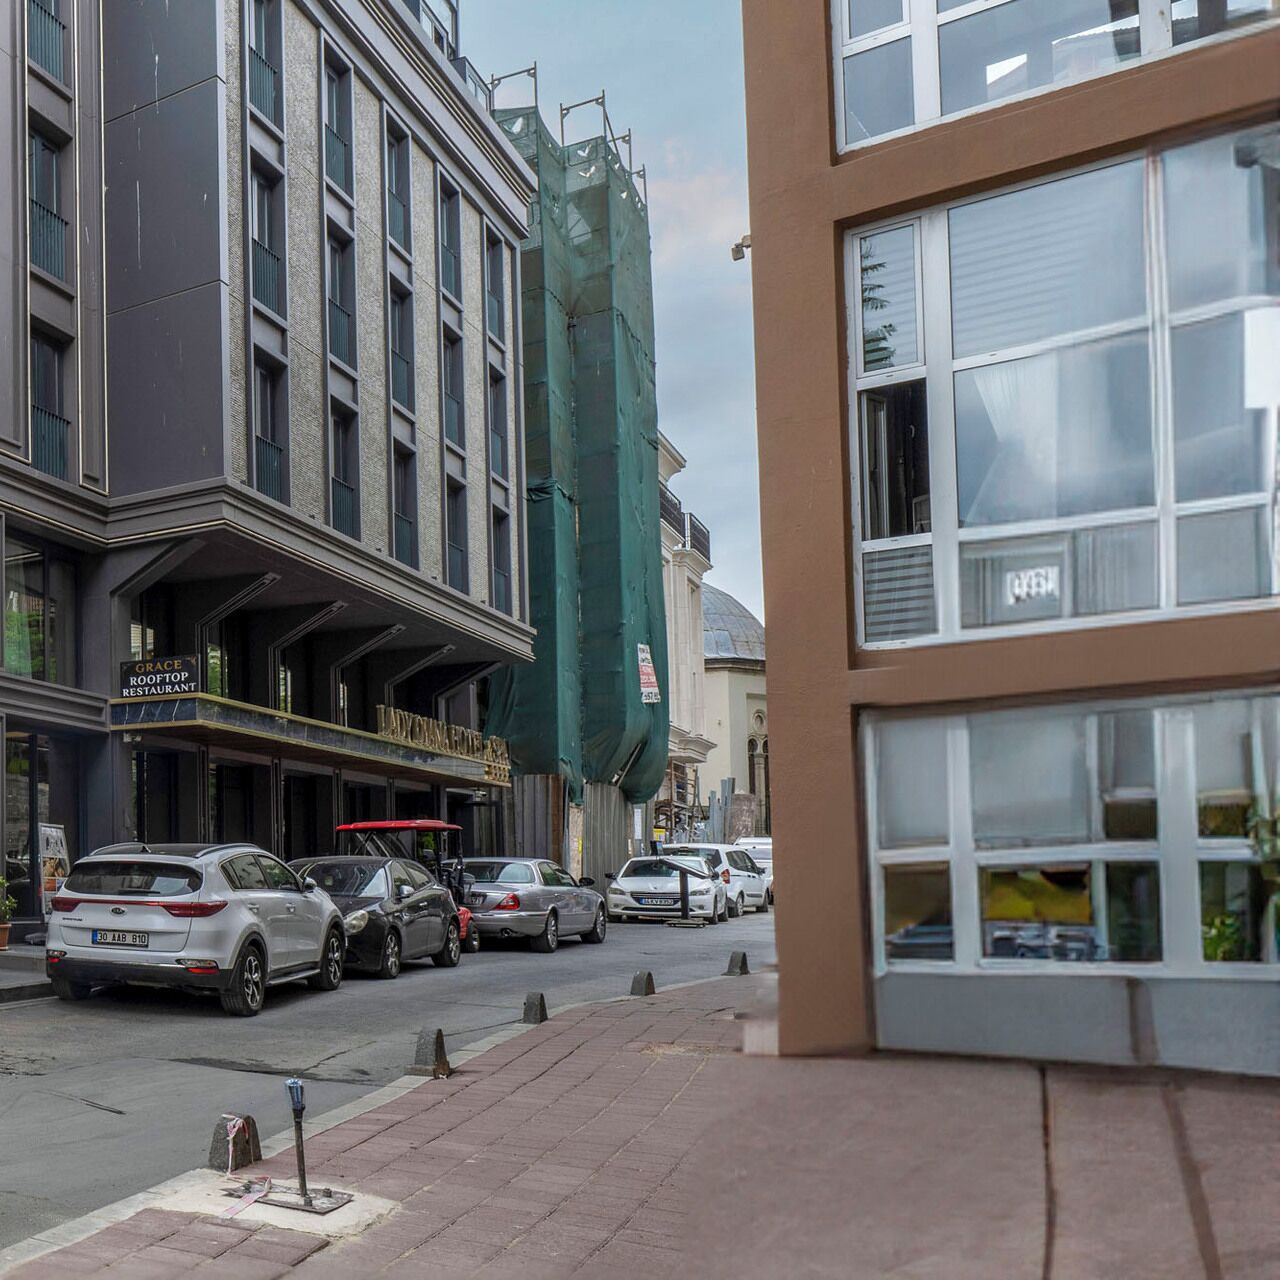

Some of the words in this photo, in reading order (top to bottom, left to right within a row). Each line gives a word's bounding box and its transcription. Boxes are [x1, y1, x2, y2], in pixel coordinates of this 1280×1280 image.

[135, 660, 182, 673] GRACE
[129, 672, 189, 686] ROOFTOP
[122, 682, 197, 697] RESTAURANT
[97, 932, 108, 941] 30
[111, 933, 127, 942] AAB
[131, 934, 147, 944] 810
